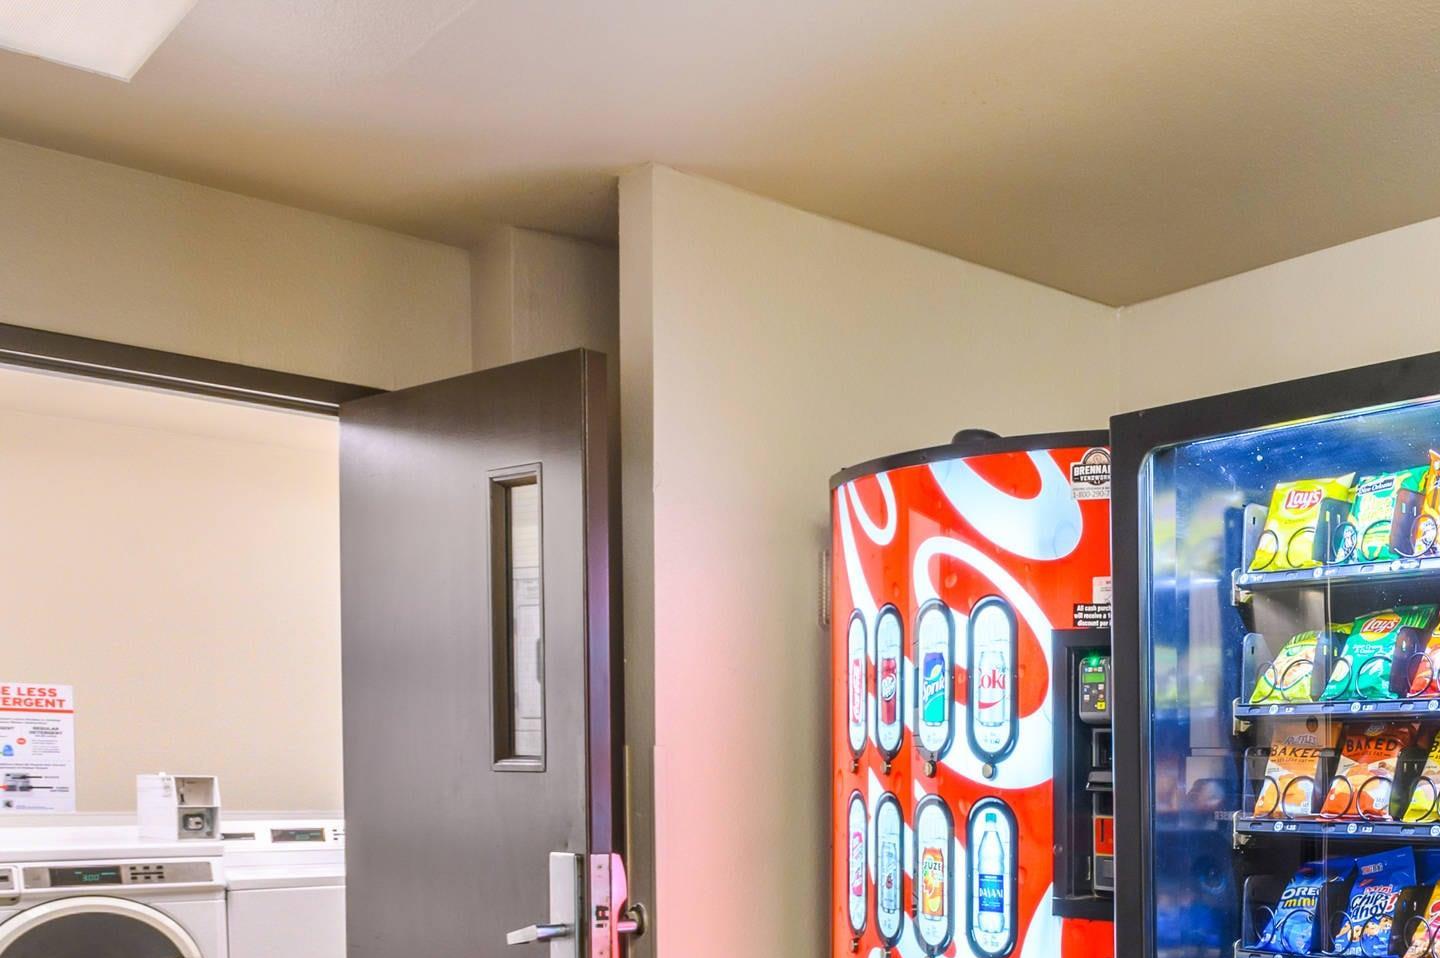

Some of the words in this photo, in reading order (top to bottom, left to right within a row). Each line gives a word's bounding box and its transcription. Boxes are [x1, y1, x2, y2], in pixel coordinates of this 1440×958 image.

[17, 687, 57, 697] LESS
[2, 698, 65, 708] ERGENT
[1271, 744, 1321, 758] BAKED
[1346, 739, 1398, 752] BAKED
[1284, 896, 1315, 908] mini
